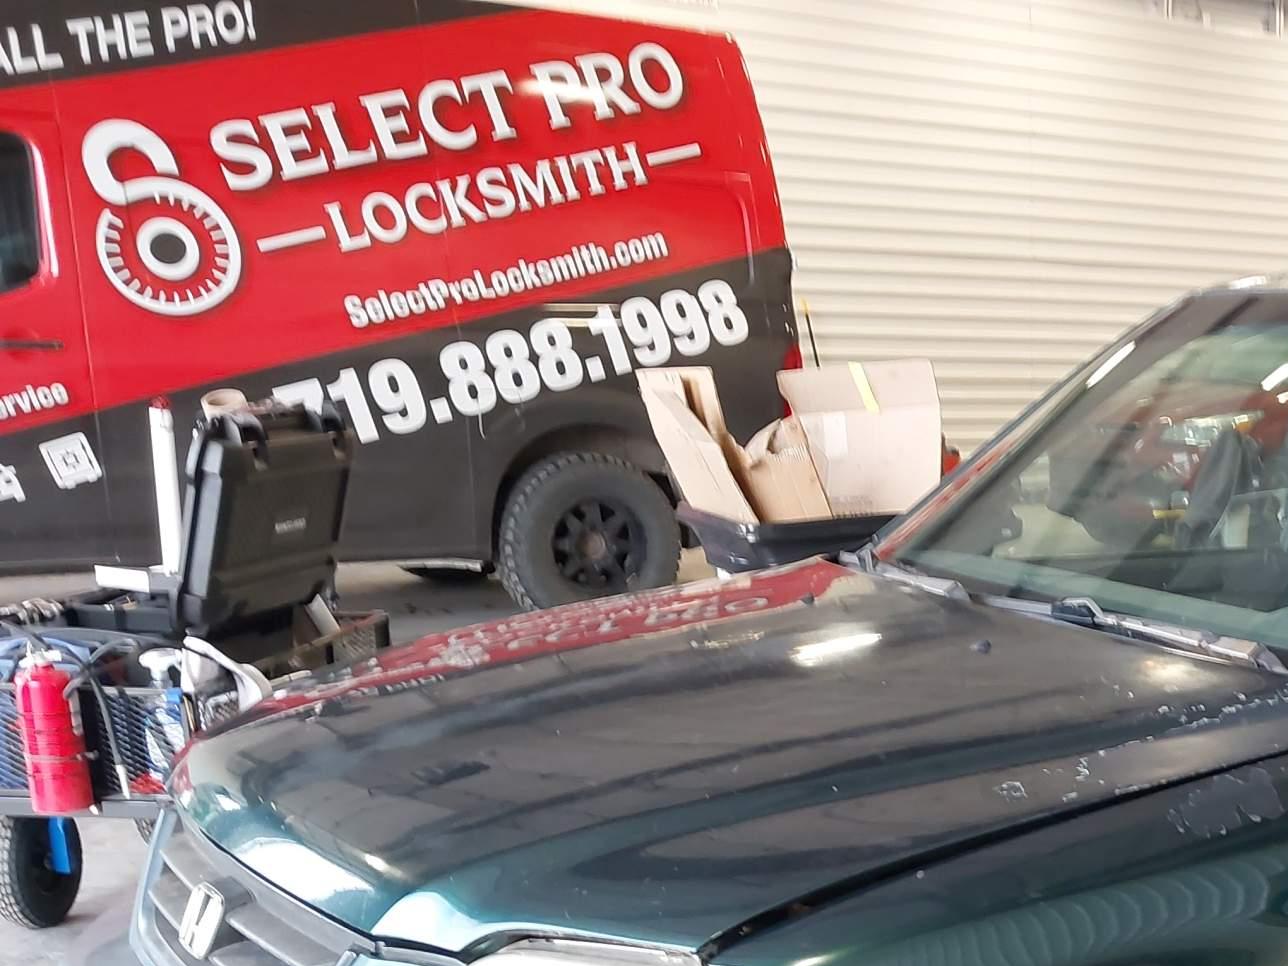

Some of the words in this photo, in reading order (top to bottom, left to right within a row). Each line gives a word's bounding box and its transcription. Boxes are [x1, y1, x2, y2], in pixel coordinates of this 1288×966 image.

[66, 11, 155, 65] THE
[161, 0, 257, 53] PRO!
[209, 69, 518, 191] SELECT
[528, 42, 683, 131] PRO
[323, 141, 649, 253] LOCKSMITH
[343, 232, 669, 328] SelectProLocksmith.com
